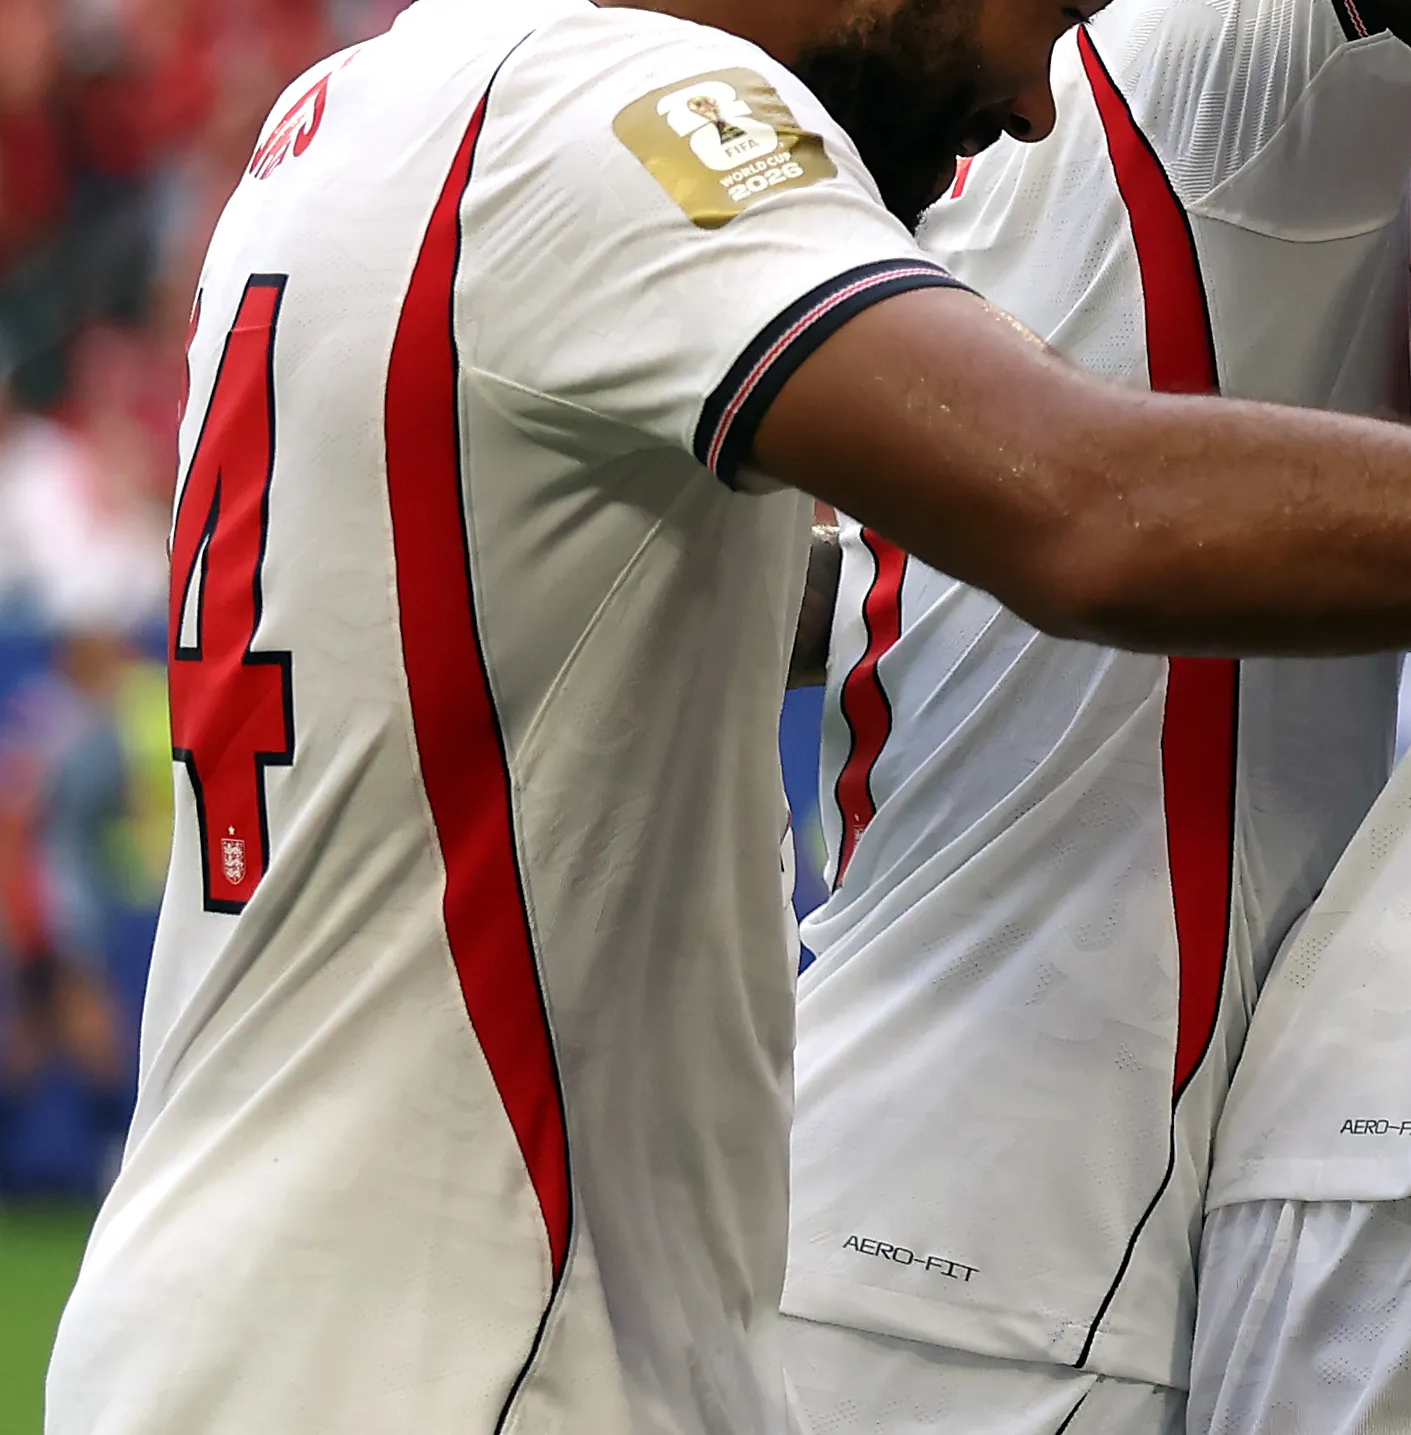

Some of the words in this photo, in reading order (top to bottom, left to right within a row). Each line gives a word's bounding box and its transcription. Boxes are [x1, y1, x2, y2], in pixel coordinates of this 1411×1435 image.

[725, 139, 760, 158] FIFA
[719, 160, 768, 188] WORLD
[766, 151, 792, 166] CUP
[727, 161, 804, 203] 2026
[842, 1234, 980, 1283] AERO-FIT
